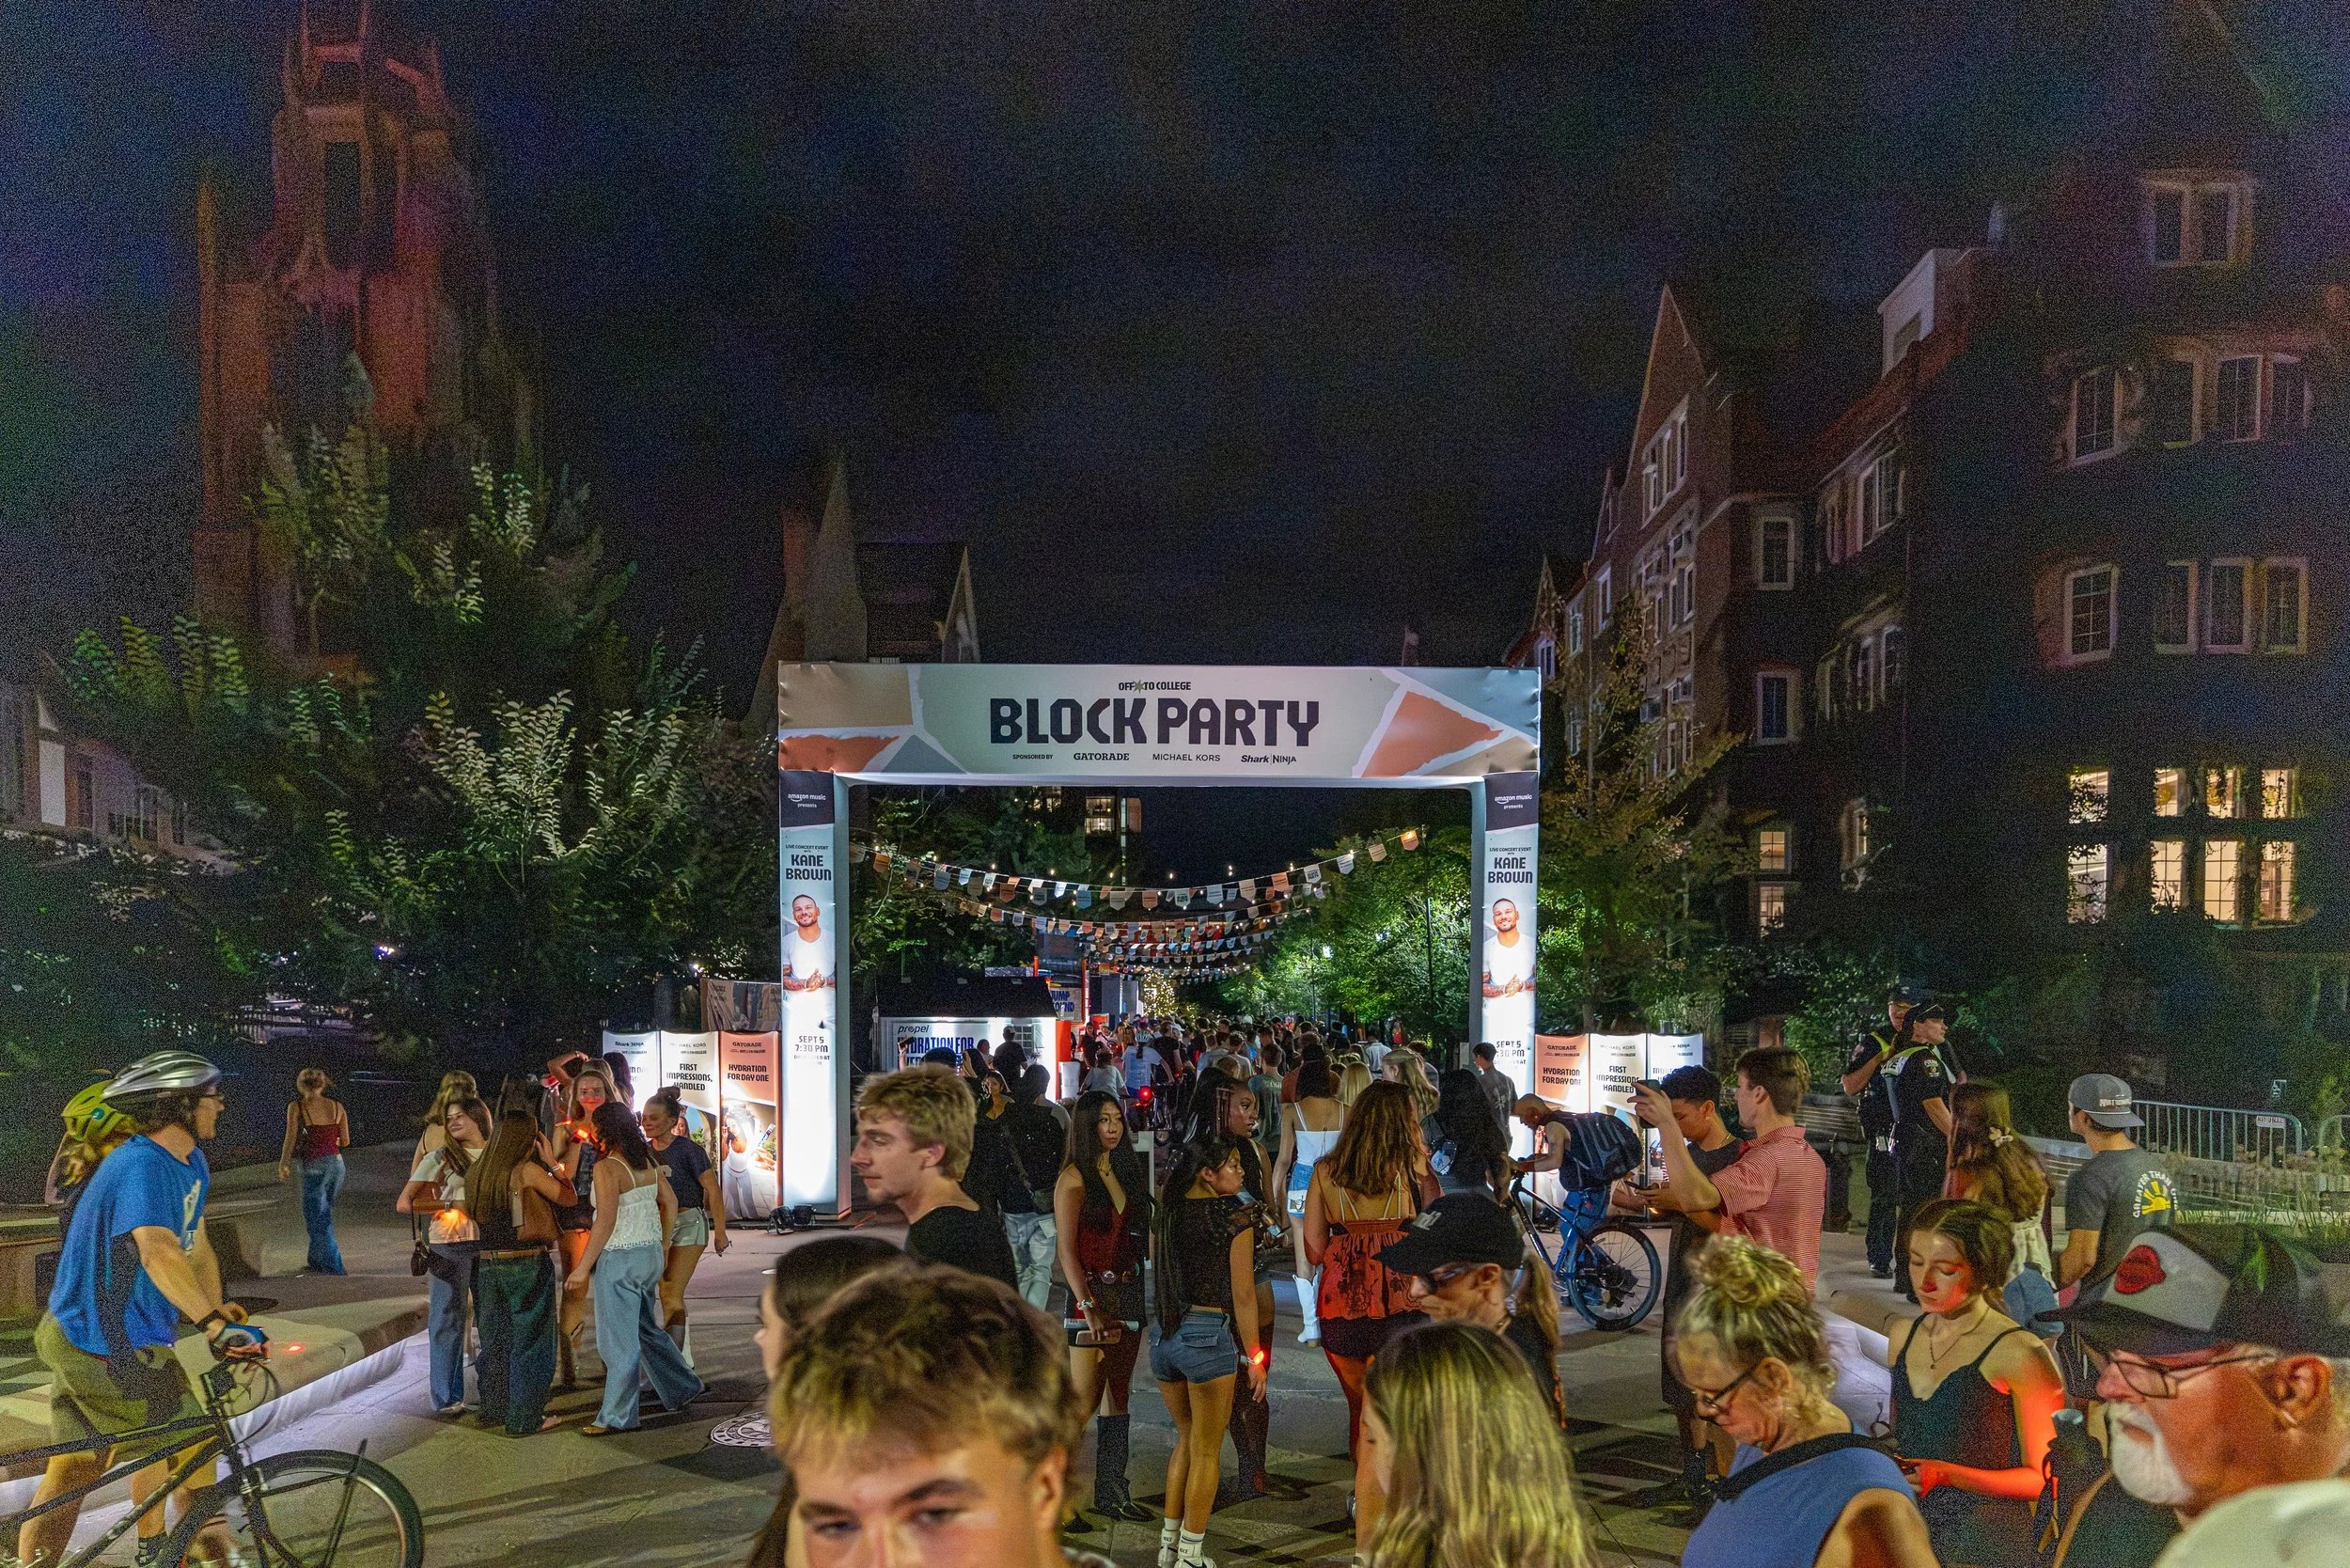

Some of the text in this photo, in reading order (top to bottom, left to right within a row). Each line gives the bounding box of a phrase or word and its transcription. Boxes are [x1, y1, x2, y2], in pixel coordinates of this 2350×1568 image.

[1119, 682, 1192, 691] OFF TO COLLEGE
[990, 698, 1320, 746] BLOCK PARTY
[1073, 752, 1130, 761] GATORADE
[1152, 753, 1221, 762] MICHAEL KORS
[1241, 754, 1269, 763] Shark
[788, 793, 809, 802] amazon
[791, 854, 824, 867] KANE
[1494, 856, 1527, 870] KANE
[785, 868, 832, 881] BROWN
[1488, 871, 1533, 884] BROWN
[898, 1025, 930, 1034] propel
[799, 1035, 824, 1044] SEPT 5
[814, 1044, 829, 1053] PM
[955, 1037, 975, 1054] FOR
[1496, 1049, 1525, 1058] :30 PM
[728, 1064, 767, 1073] HYDRATION
[1543, 1067, 1580, 1076] HYDRATION
[1608, 1065, 1627, 1074] FIRST
[666, 1072, 713, 1082] IMPRESSIONS,
[1556, 1076, 1569, 1085] DAY
[1569, 1077, 1582, 1086] ONE
[673, 1082, 706, 1091] HANDLED
[1603, 1084, 1635, 1093] HANDLED
